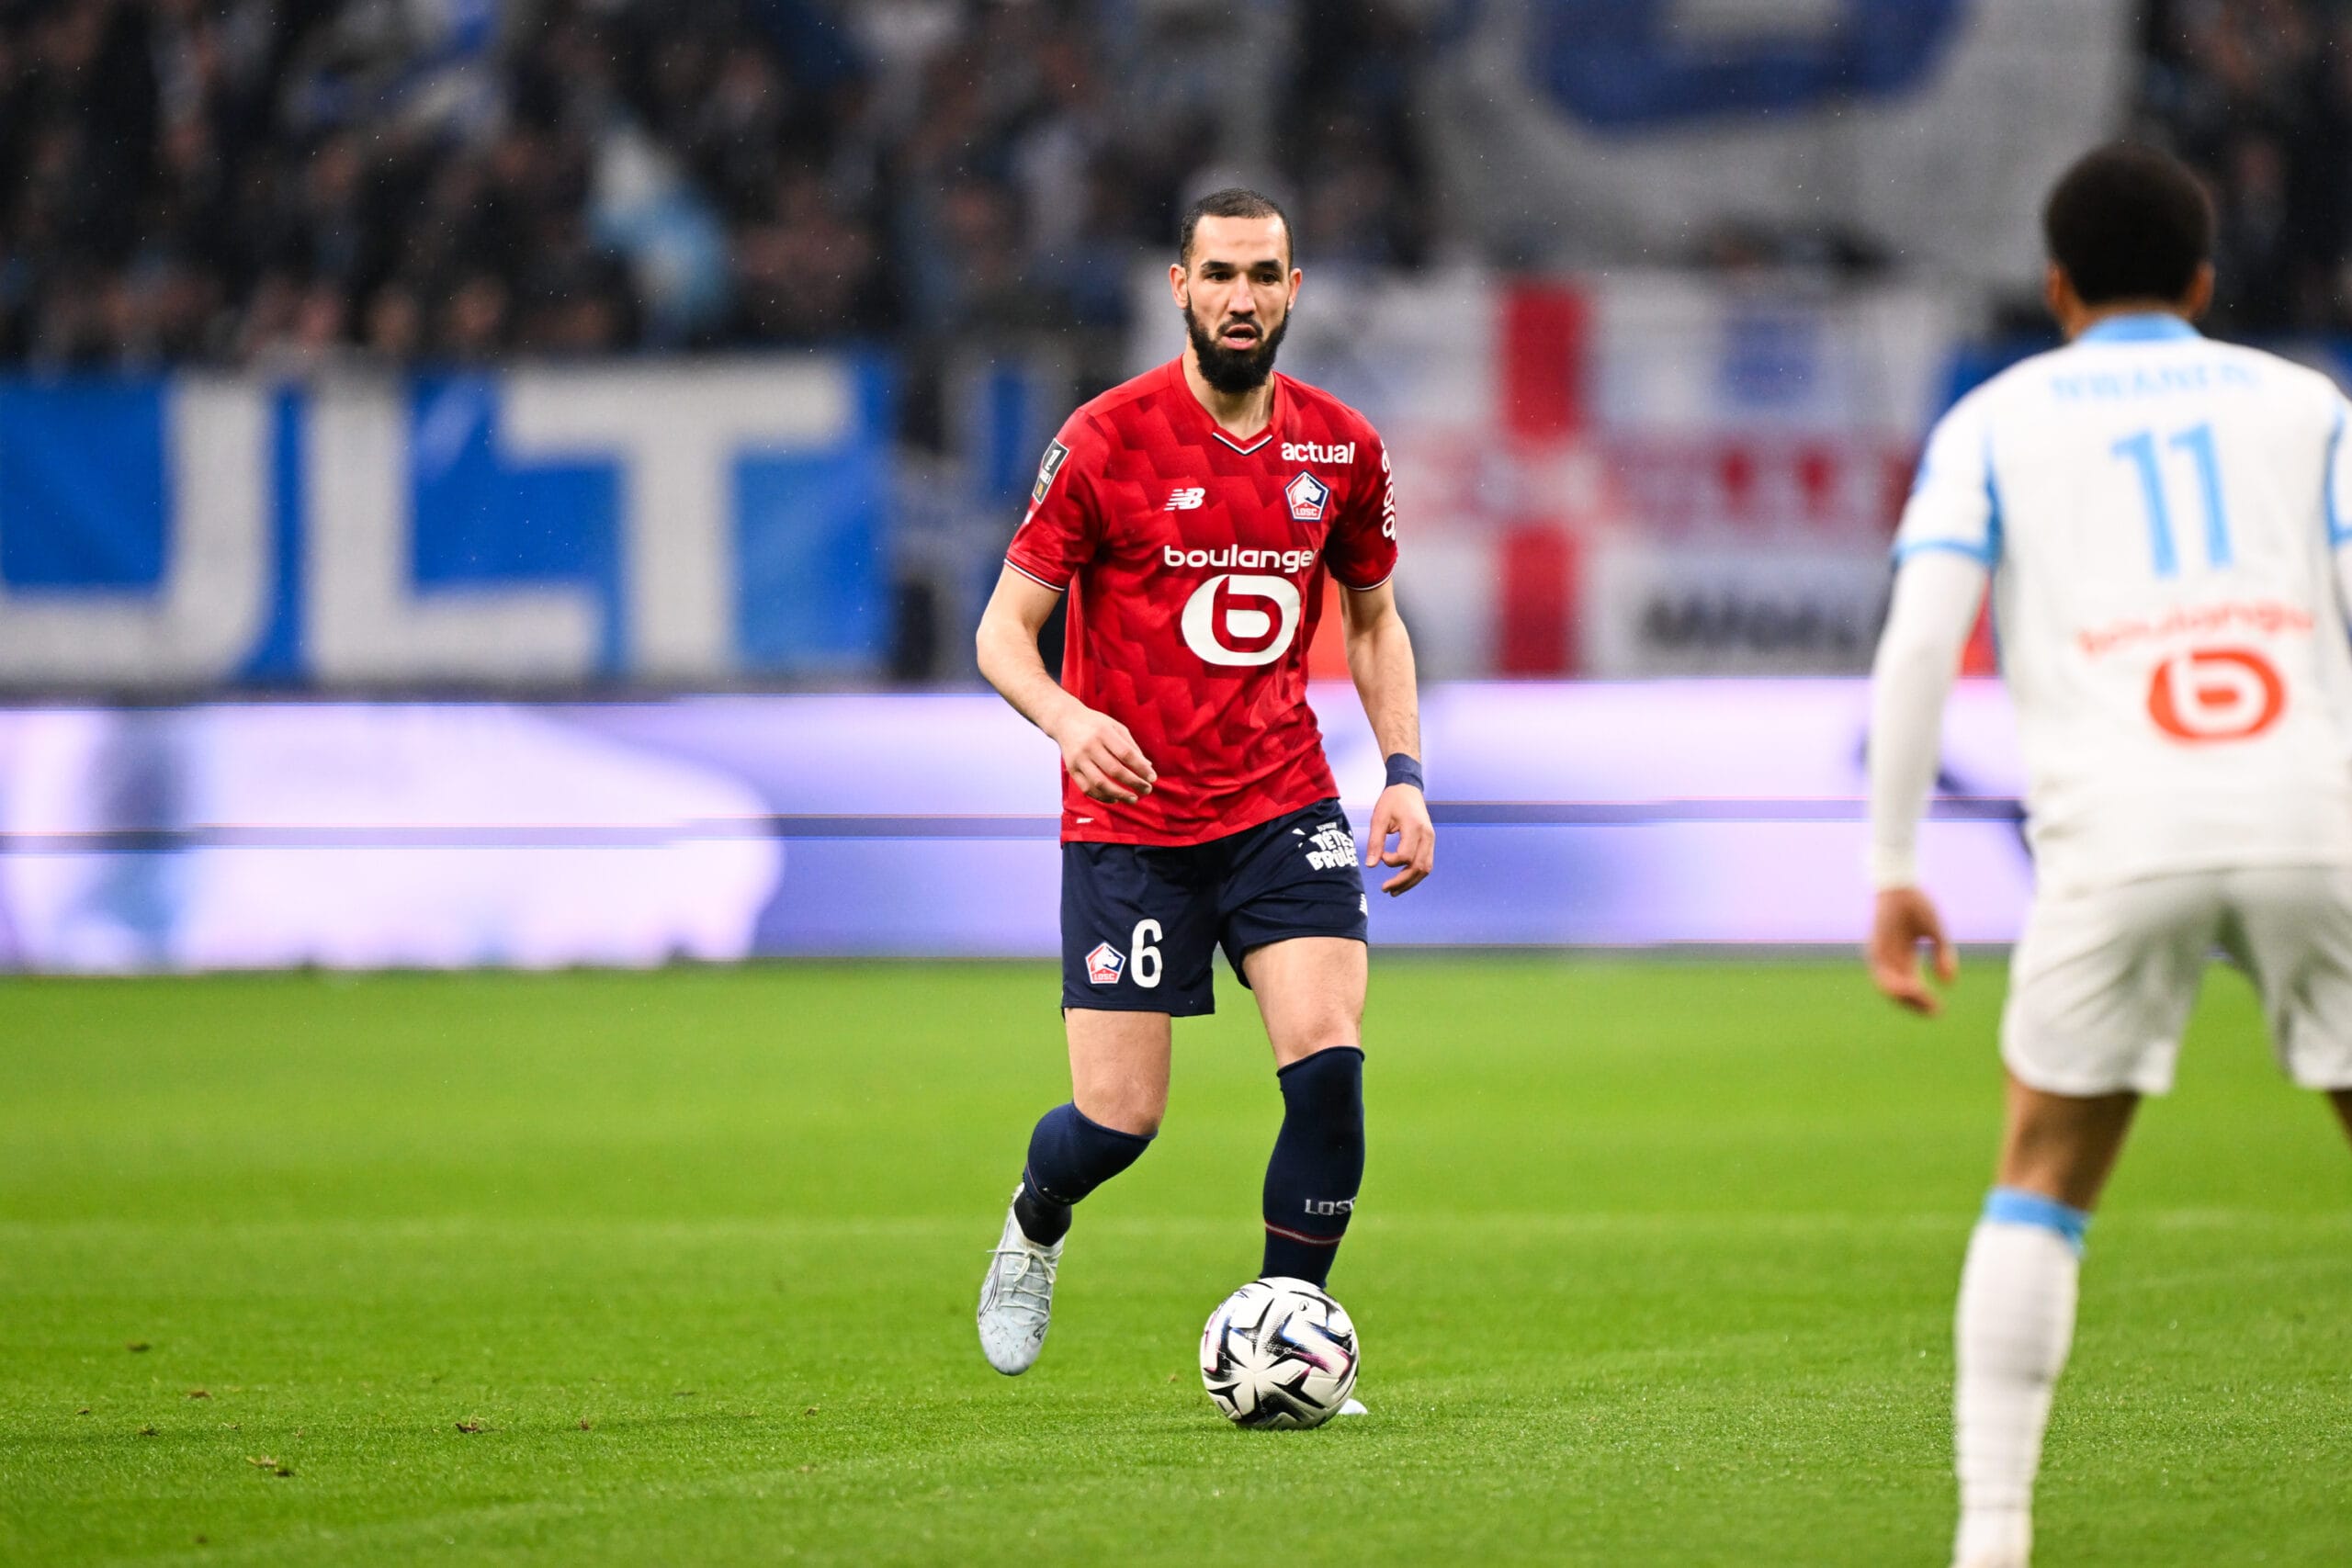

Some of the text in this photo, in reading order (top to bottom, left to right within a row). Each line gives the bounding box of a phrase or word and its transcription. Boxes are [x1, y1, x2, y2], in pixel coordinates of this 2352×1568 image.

[1281, 441, 1355, 465] actual
[1295, 507, 1317, 516] LOSC
[2110, 422, 2234, 580] 11
[1164, 544, 1320, 573] boulange
[1131, 919, 1163, 988] 6
[1094, 973, 1115, 981] LOSC
